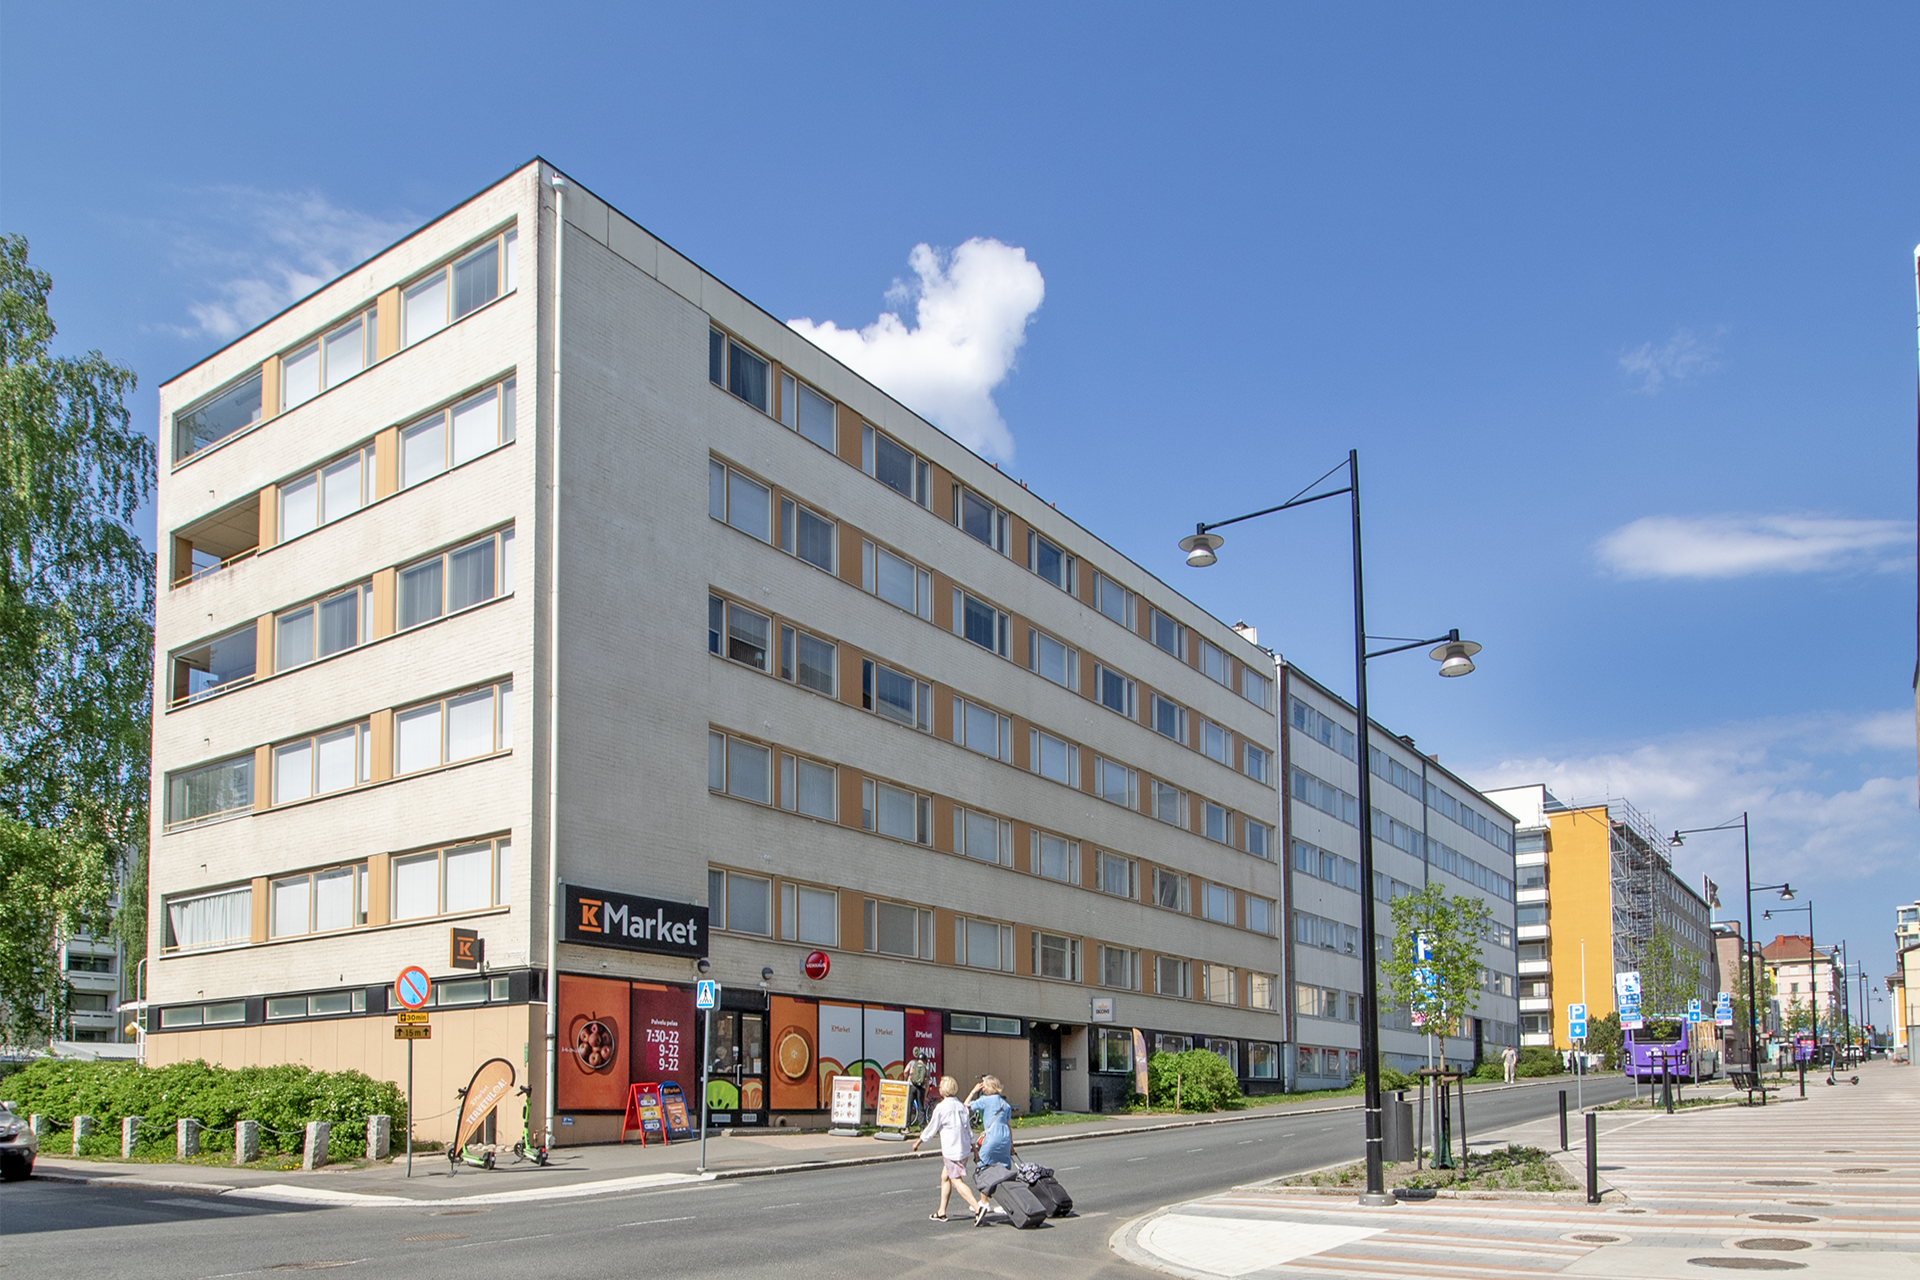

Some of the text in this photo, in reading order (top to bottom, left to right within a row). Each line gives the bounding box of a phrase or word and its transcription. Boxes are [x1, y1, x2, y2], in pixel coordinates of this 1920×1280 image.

[458, 939, 473, 958] K
[1571, 1005, 1584, 1020] P
[646, 1029, 679, 1043] 7:30-22
[658, 1044, 679, 1057] 9-22
[658, 1058, 679, 1071] 9-22
[466, 1078, 508, 1125] TERVETULOA!
